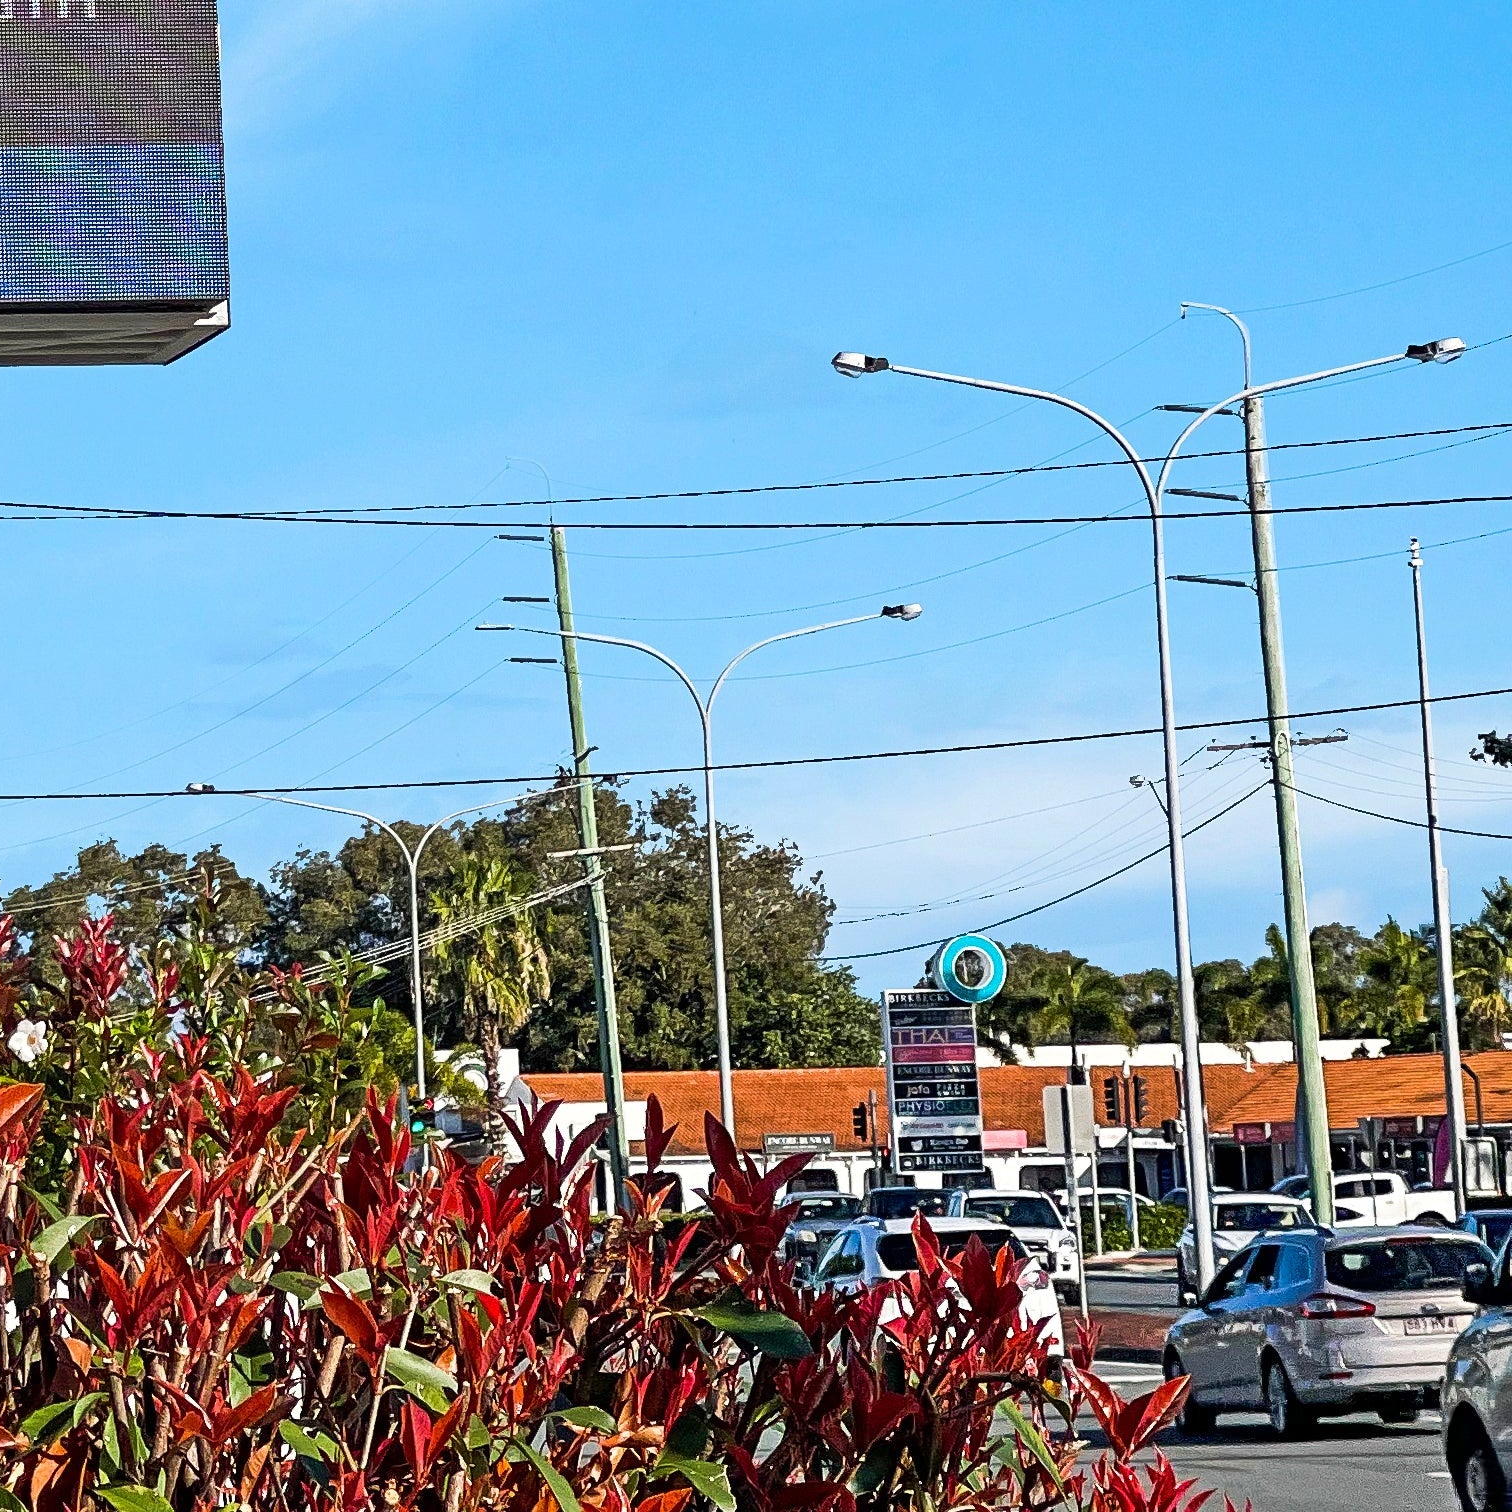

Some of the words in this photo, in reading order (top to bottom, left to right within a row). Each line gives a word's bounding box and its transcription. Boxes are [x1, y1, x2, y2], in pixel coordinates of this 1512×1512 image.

[888, 993, 950, 1004] BIRKBECKS
[892, 1029, 949, 1045] THAI
[915, 1154, 981, 1166] BIRKBECKS
